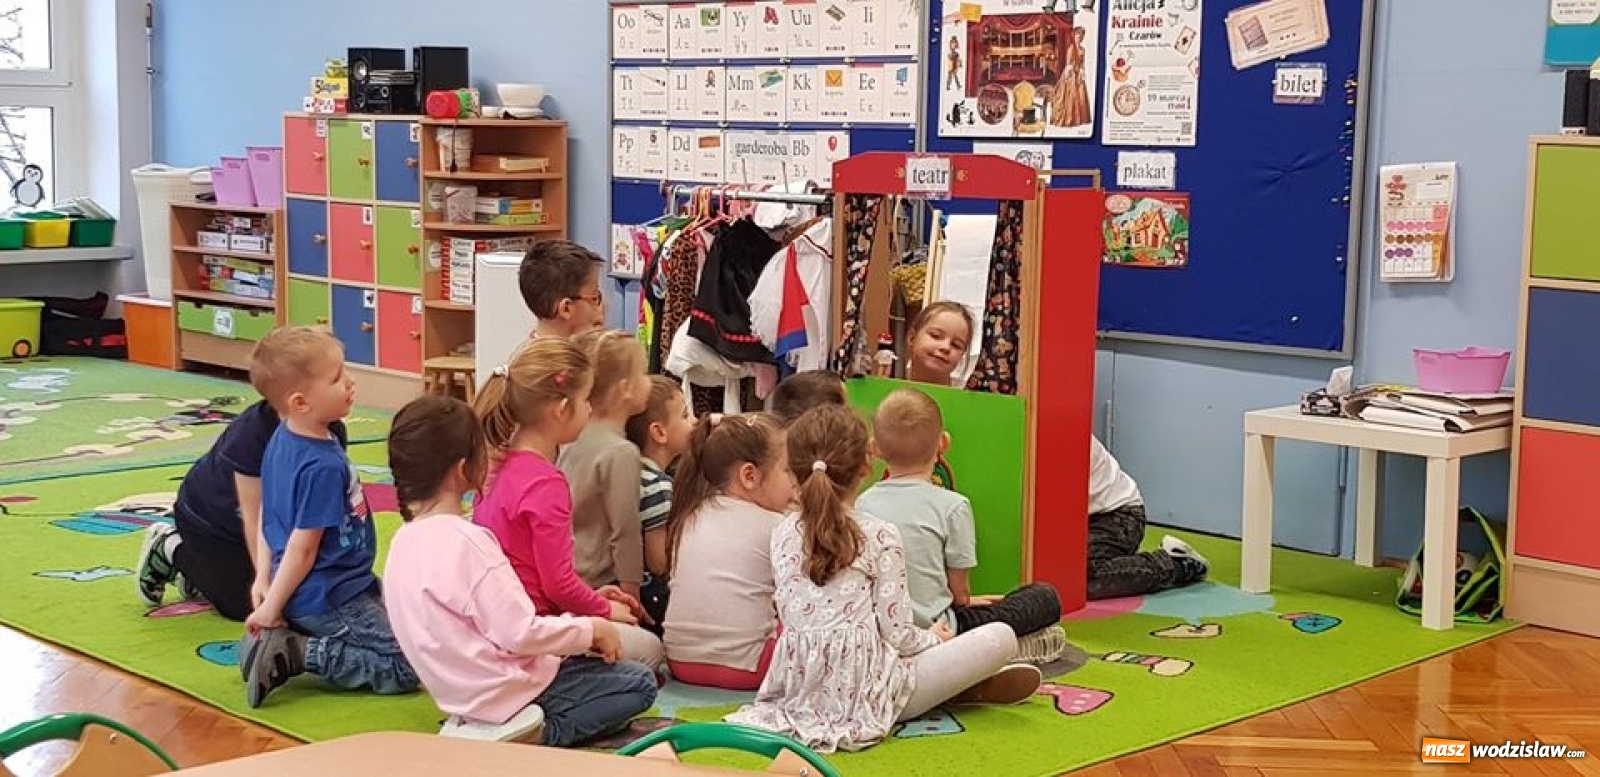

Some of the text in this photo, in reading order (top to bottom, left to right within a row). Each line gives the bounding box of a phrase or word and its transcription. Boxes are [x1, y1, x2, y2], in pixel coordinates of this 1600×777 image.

[617, 13, 635, 29] Oo
[674, 14, 690, 29] Aa
[732, 11, 749, 32] Yy
[791, 9, 812, 26] Uu
[1111, 15, 1163, 29] Krainie
[728, 75, 754, 91] Mm
[793, 73, 812, 91] Kk
[859, 73, 876, 91] Ee
[1280, 74, 1317, 93] bilet
[619, 133, 634, 153] Pp
[672, 135, 691, 151] Dd
[734, 139, 788, 157] garderoba
[792, 139, 811, 157] Bb
[912, 167, 948, 185] teatr
[1123, 163, 1167, 182] plakat
